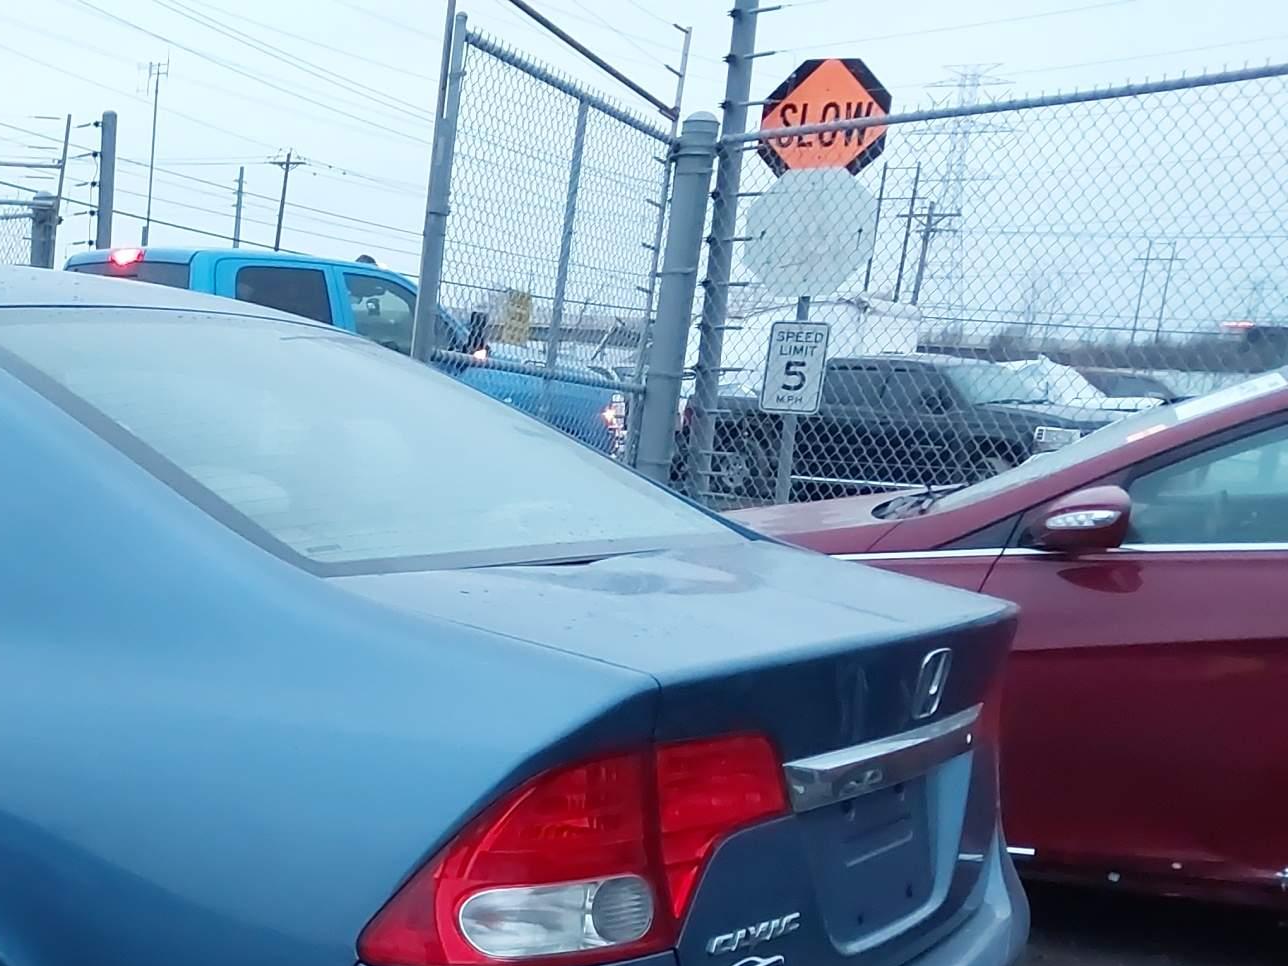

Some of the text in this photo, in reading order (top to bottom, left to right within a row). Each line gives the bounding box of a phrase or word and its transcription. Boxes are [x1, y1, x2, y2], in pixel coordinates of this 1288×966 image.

[776, 101, 874, 148] SLOW
[776, 331, 824, 343] SPEED
[779, 345, 818, 356] LIMIT
[781, 360, 807, 391] 5
